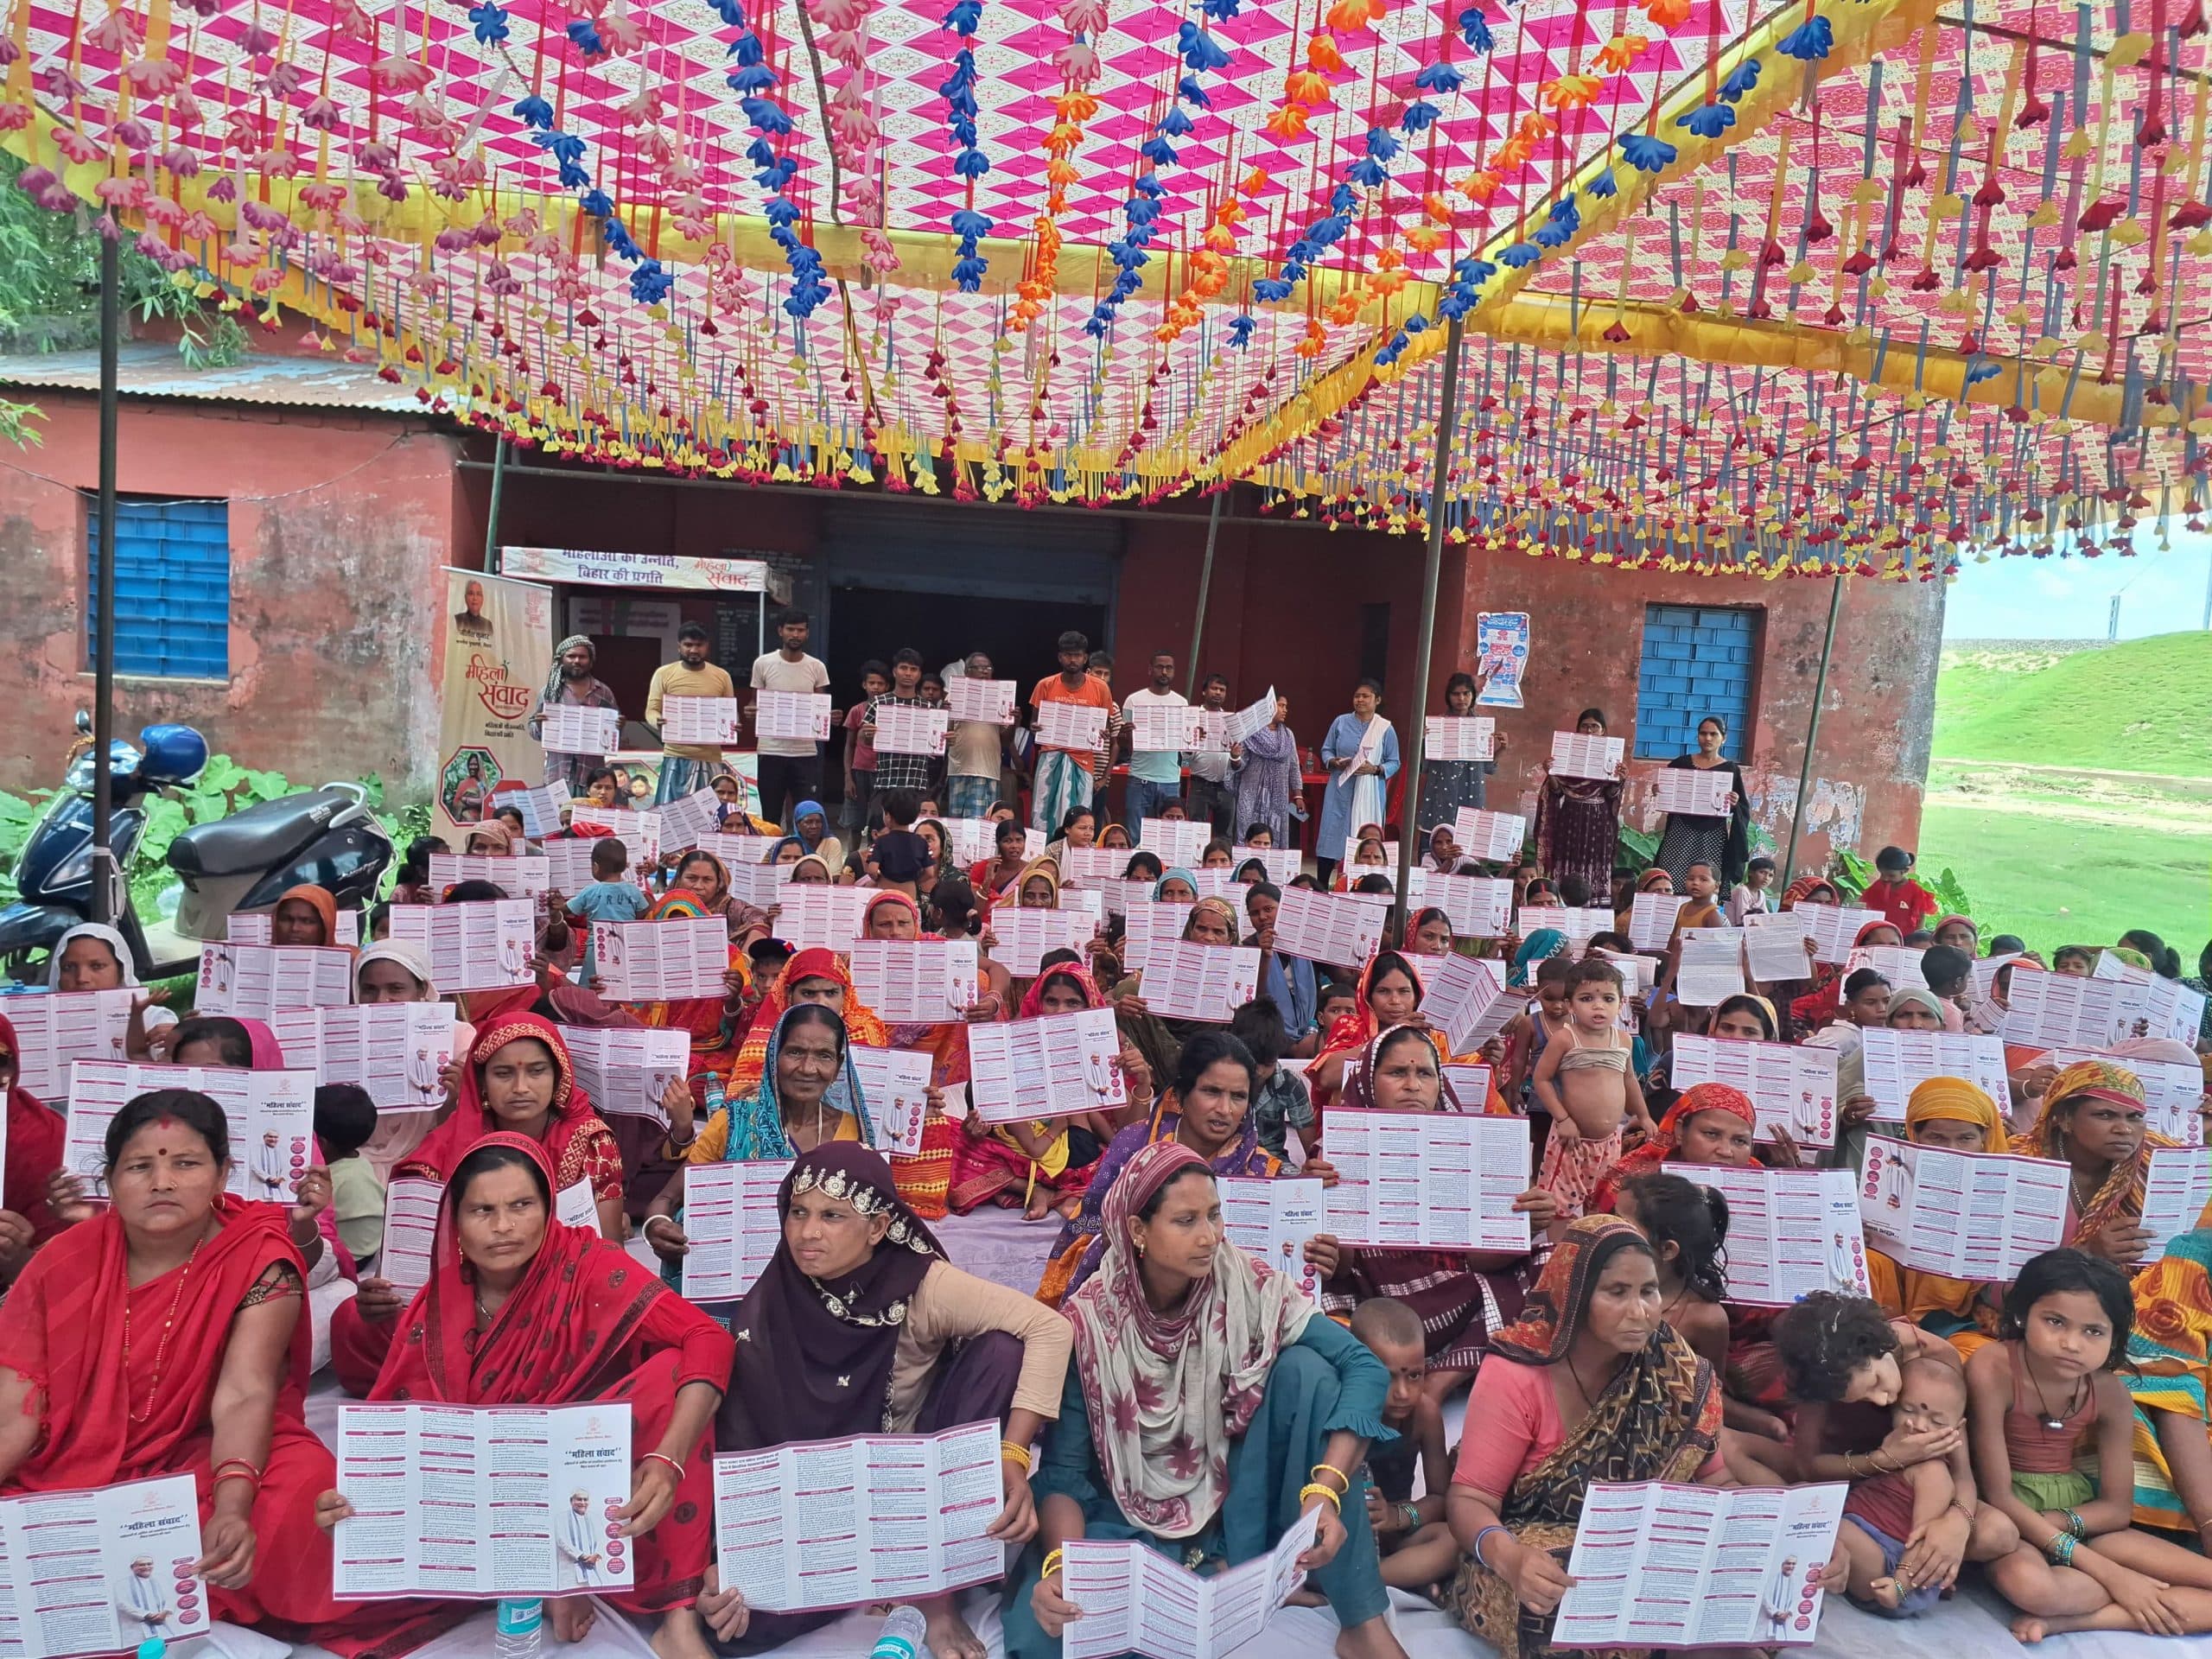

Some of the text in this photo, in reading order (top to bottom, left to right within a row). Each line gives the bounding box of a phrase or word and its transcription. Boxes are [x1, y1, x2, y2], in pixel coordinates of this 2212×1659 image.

[577, 564, 664, 584] बिहार की प्रगति
[466, 654, 508, 683] महिला
[478, 681, 531, 720] संवाद
